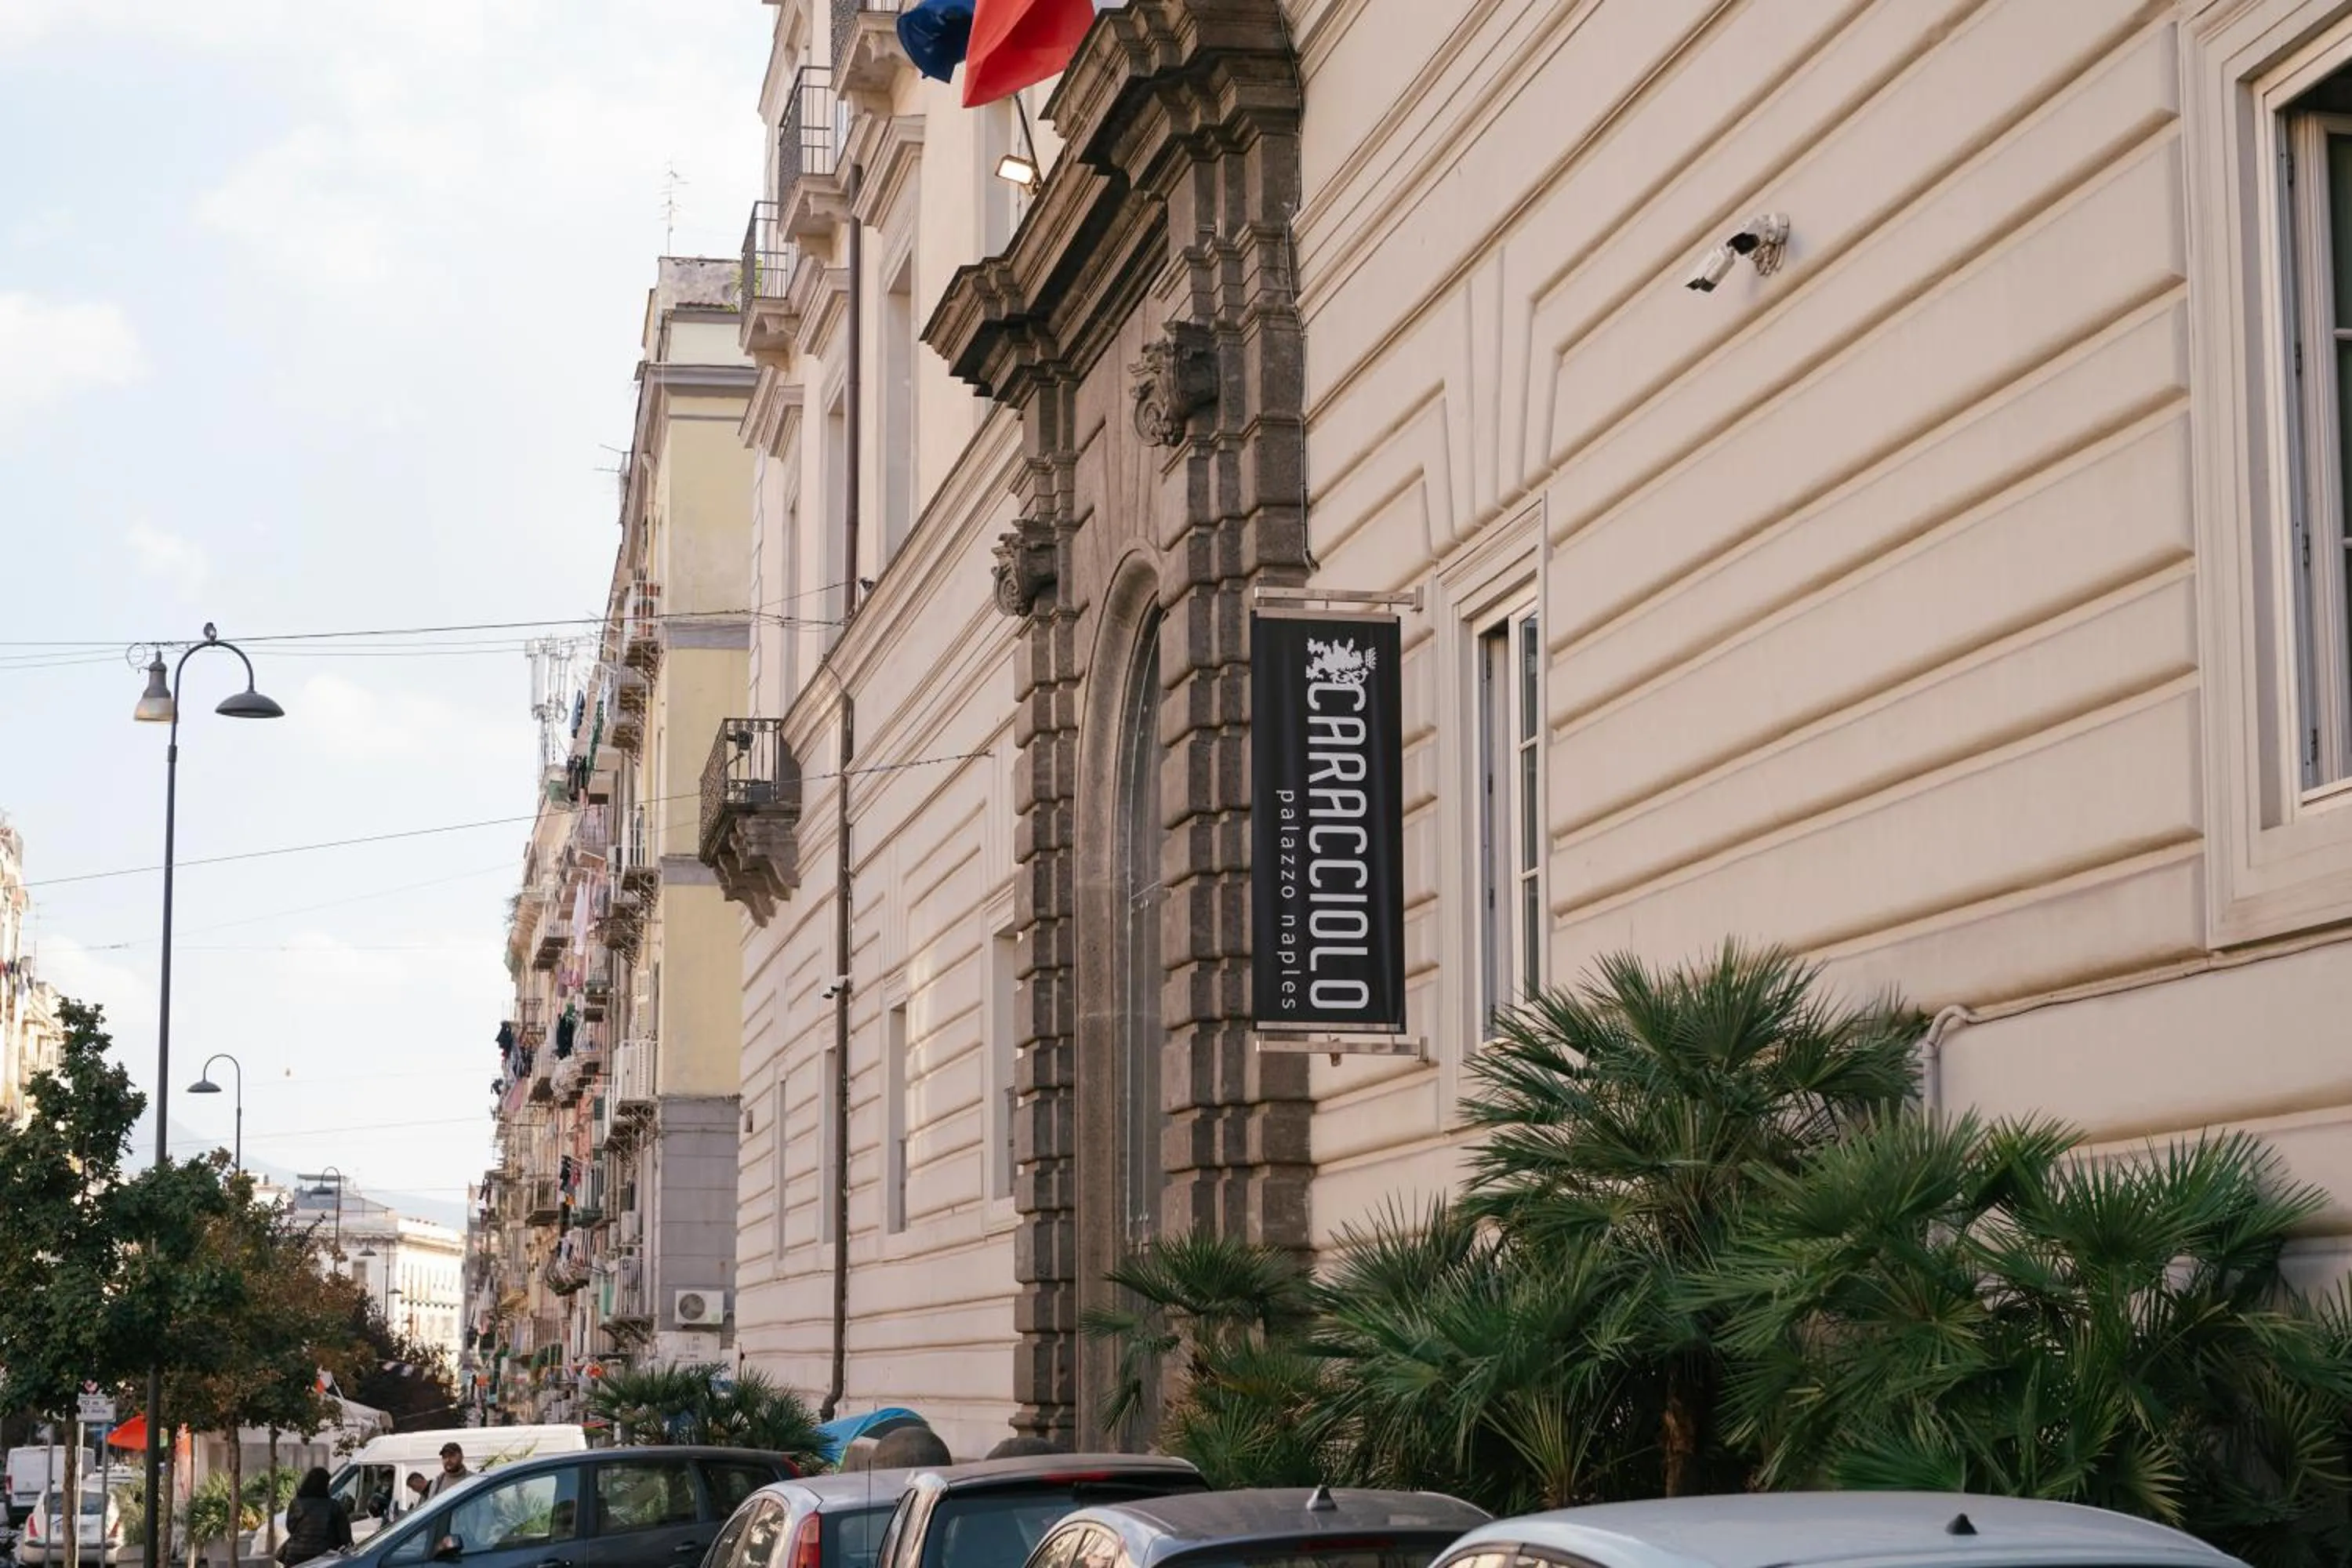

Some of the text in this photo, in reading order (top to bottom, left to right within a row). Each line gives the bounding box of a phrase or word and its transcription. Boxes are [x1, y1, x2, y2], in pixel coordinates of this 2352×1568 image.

[1276, 789, 1301, 1009] palazzo naples
[1307, 681, 1369, 1009] CARACCIOLO
